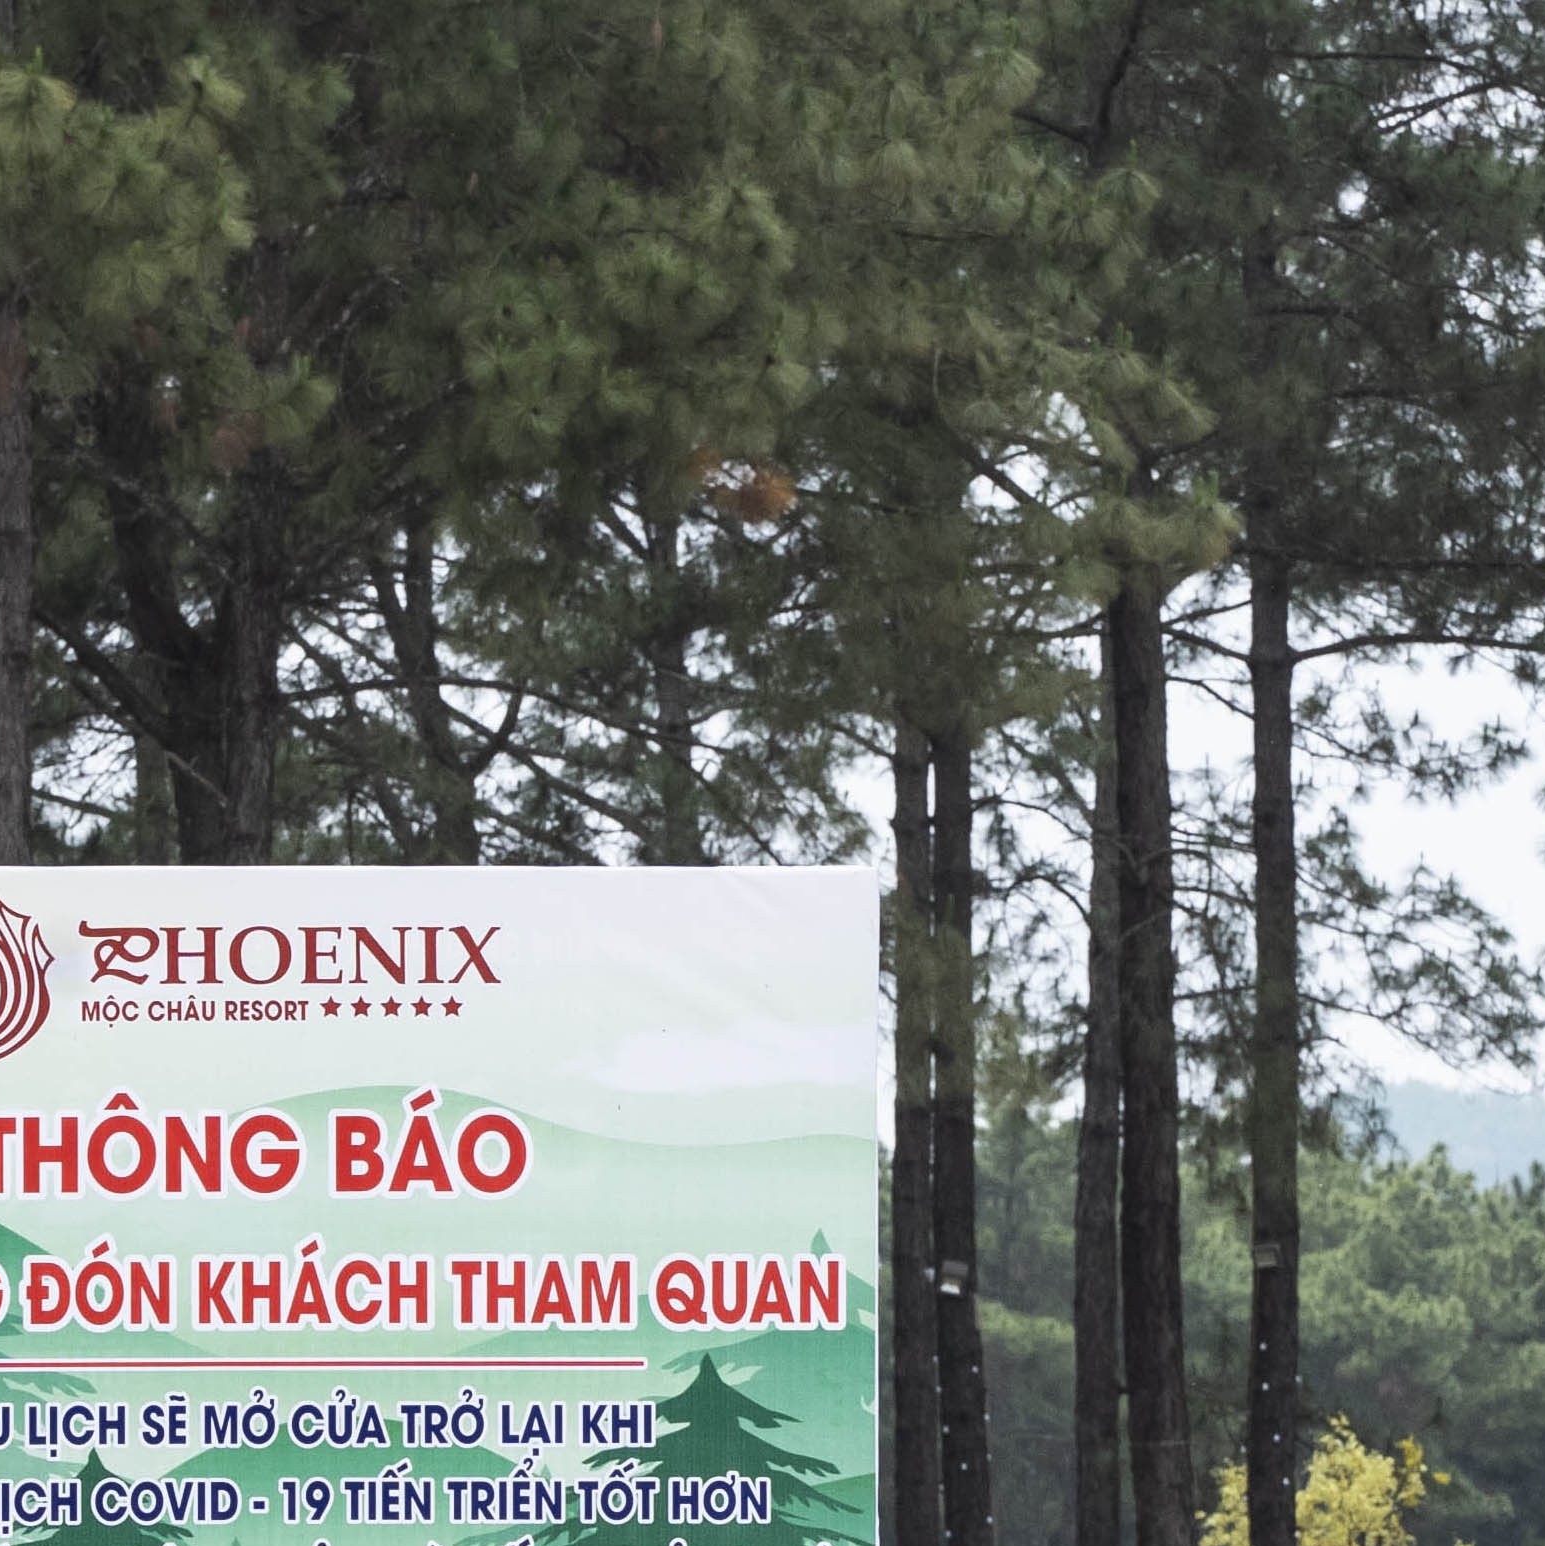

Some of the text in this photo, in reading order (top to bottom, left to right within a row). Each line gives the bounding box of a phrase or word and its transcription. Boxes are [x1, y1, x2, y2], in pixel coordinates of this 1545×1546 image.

[78, 920, 501, 985] PHOENIX
[81, 995, 309, 1028] MỘC CHÂU RESORT
[334, 1090, 528, 1194] BÁO
[25, 1240, 171, 1327] ĐÓN
[197, 1240, 429, 1326] KHÁCH
[450, 1259, 632, 1325] THAM
[654, 1259, 840, 1325] QUAN
[27, 1404, 127, 1458] LỊCH
[141, 1394, 188, 1446] SẼ
[203, 1388, 277, 1446] MỞ
[290, 1388, 388, 1446] CỬA
[399, 1388, 486, 1446] TRỞ
[500, 1403, 564, 1457] LẠI
[581, 1403, 655, 1445] KHI
[94, 1480, 239, 1523] COVID
[281, 1479, 332, 1522] 19
[343, 1461, 432, 1522] TIẾN
[446, 1456, 563, 1521] TRIỂN
[577, 1461, 657, 1522] TỐT
[671, 1473, 770, 1522] HƠN
